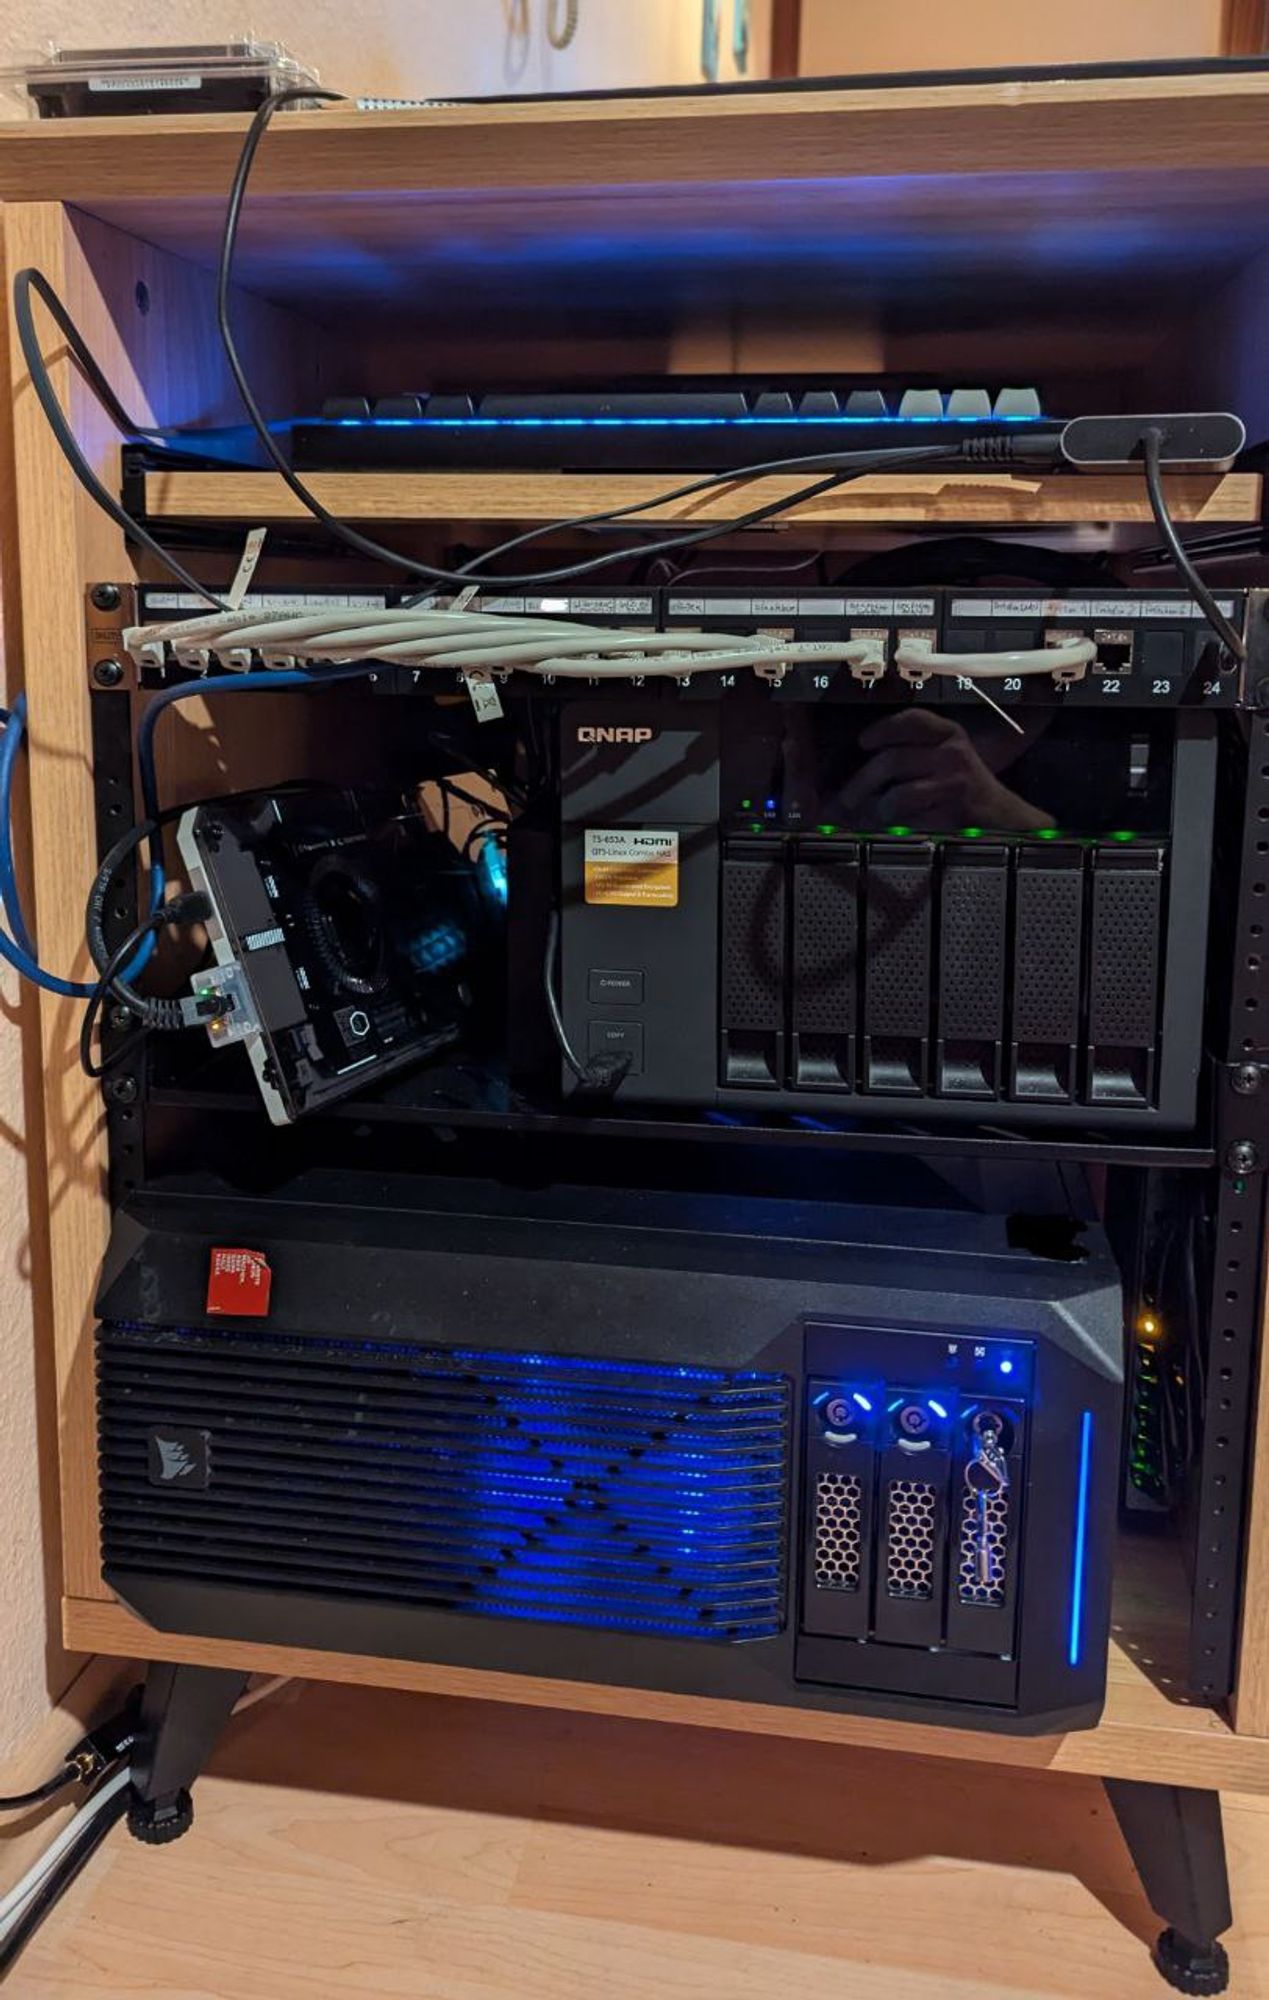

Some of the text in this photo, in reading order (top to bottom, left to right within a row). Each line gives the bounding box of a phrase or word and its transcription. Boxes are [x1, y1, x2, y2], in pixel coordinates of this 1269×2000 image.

[412, 670, 421, 683] 7
[630, 674, 645, 687] 12
[675, 676, 691, 687] 13
[720, 675, 735, 687] 14
[813, 676, 829, 688] 16
[957, 677, 973, 690] 19
[1004, 678, 1021, 691] 20
[1102, 679, 1121, 693] 22
[1152, 680, 1170, 694] 23
[1203, 681, 1221, 695] 24
[578, 726, 652, 743] QNAP
